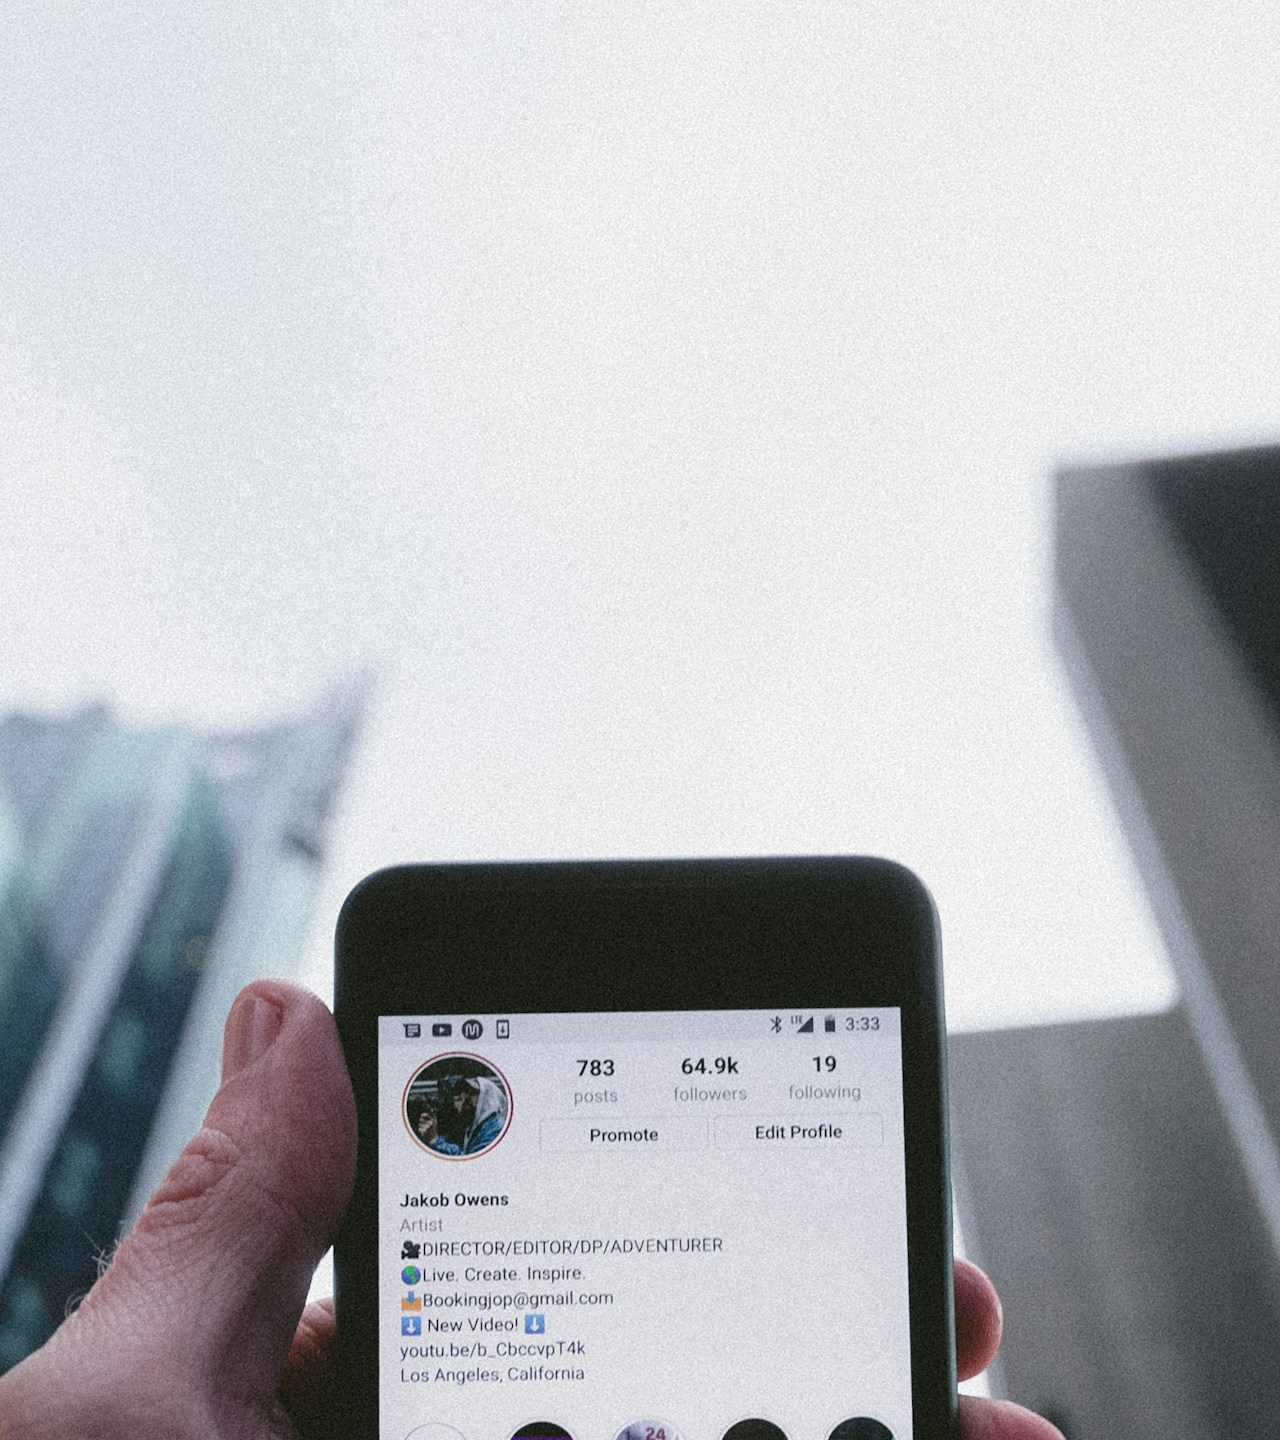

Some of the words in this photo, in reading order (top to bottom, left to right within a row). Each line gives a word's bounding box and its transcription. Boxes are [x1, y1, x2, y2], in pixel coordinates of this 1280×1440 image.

[845, 1016, 881, 1032] 3:33
[576, 1059, 616, 1077] 783
[680, 1055, 740, 1076] 64.9k
[812, 1055, 838, 1073] 19
[573, 1089, 619, 1106] posts
[673, 1086, 748, 1102] followers
[788, 1084, 862, 1103] following
[589, 1127, 660, 1143] Promote
[755, 1124, 786, 1140] Edit
[790, 1122, 844, 1140] Profile
[399, 1191, 450, 1208] Jakob
[454, 1192, 510, 1208] Owens
[399, 1217, 444, 1233] Artist
[421, 1237, 724, 1257] DIRECTOR/EDITOR/DP/ADVENTURER
[421, 1267, 458, 1283] Live.
[463, 1266, 521, 1283] Create.
[526, 1265, 586, 1284] Inspire.
[421, 1290, 615, 1311] Bookingjop@gmail.com
[427, 1317, 464, 1333] New
[468, 1316, 519, 1333] Video!
[399, 1368, 430, 1384] Los
[434, 1367, 504, 1387] Angeles,
[507, 1365, 586, 1382] California
